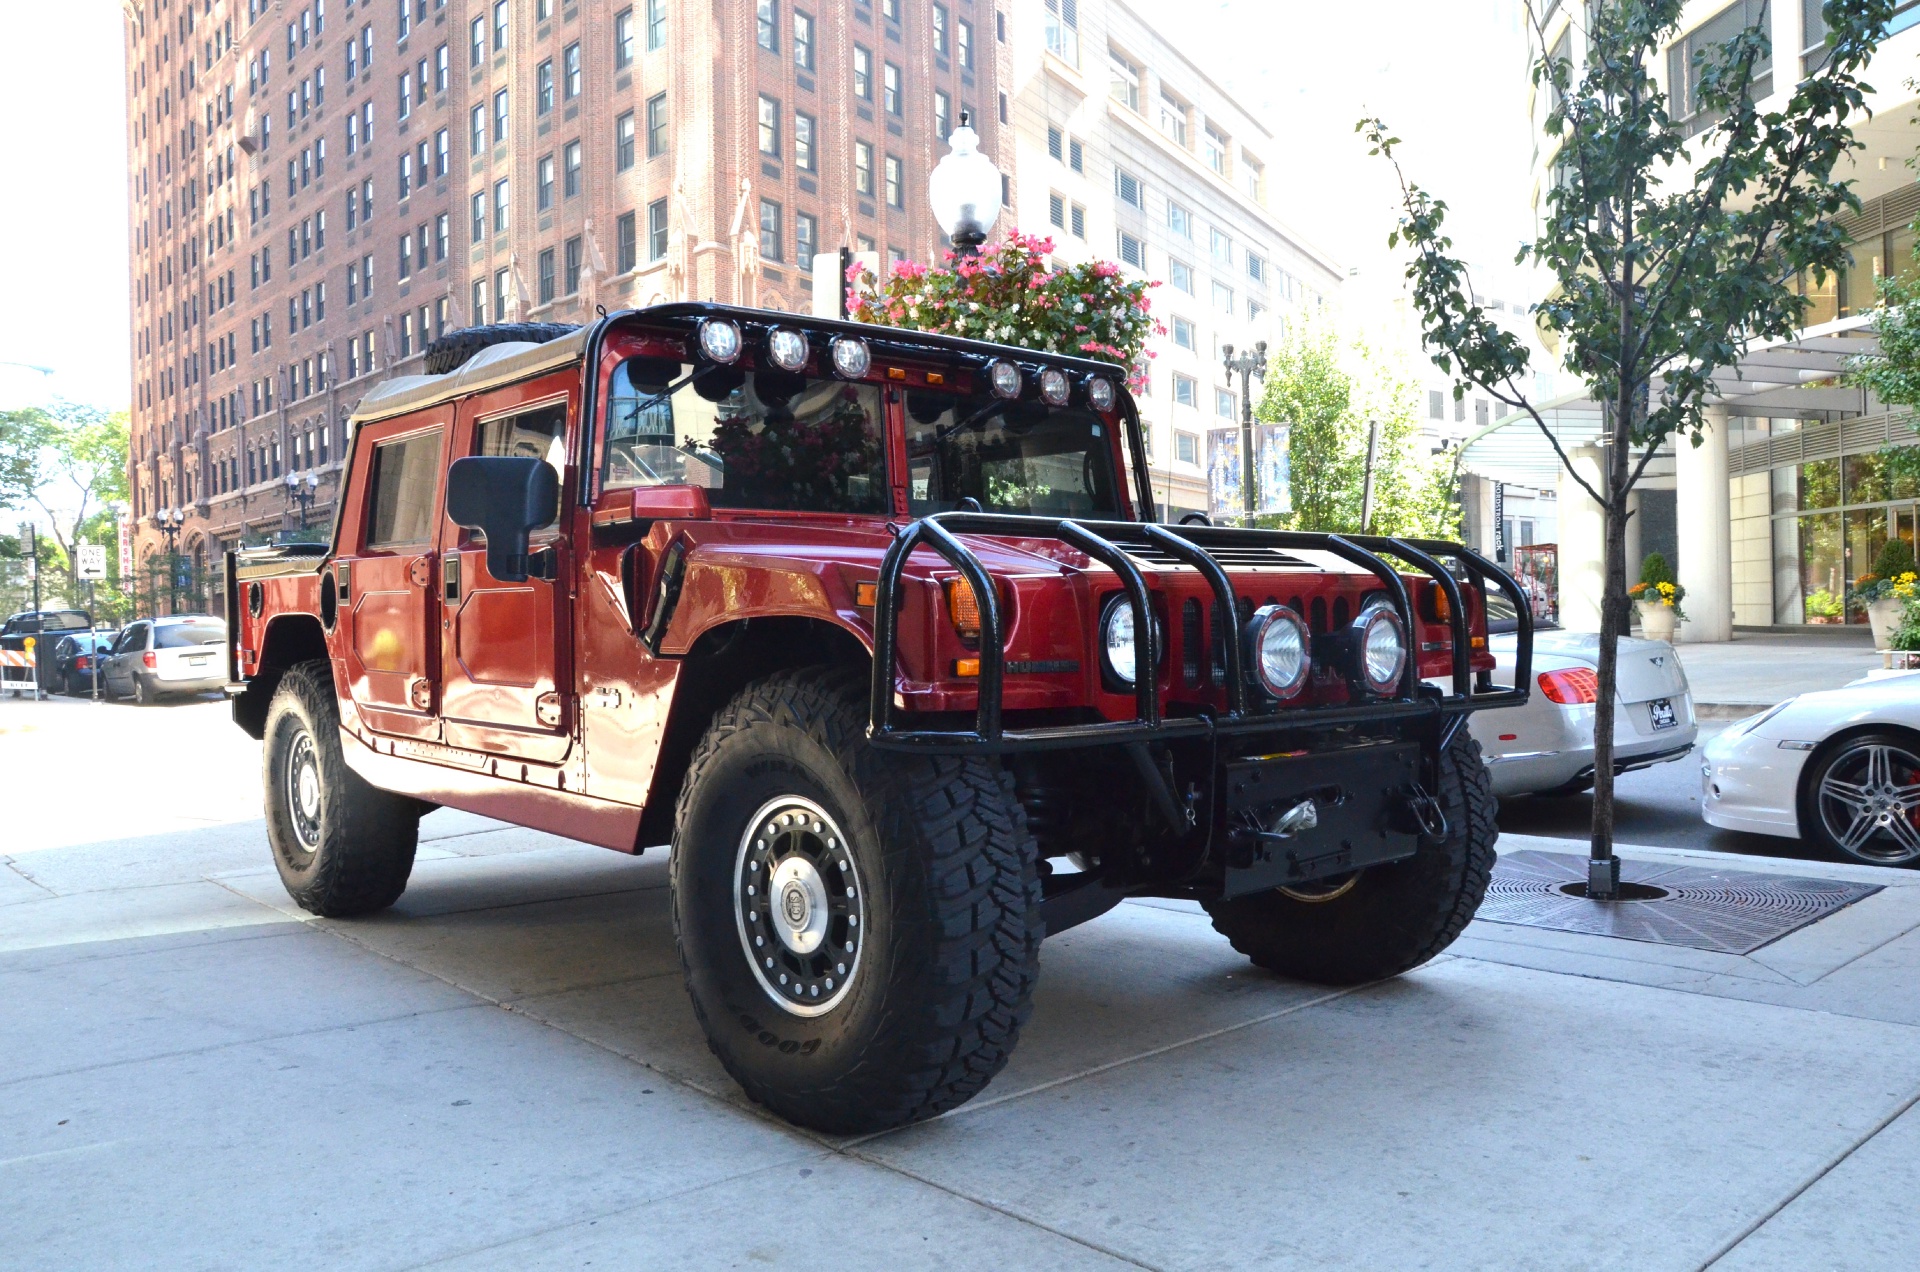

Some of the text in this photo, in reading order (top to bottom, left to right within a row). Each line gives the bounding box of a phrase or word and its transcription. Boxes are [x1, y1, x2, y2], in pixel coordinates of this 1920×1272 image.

[1496, 530, 1504, 551] rack
[81, 557, 101, 565] WAY
[122, 521, 130, 592] HERSHES
